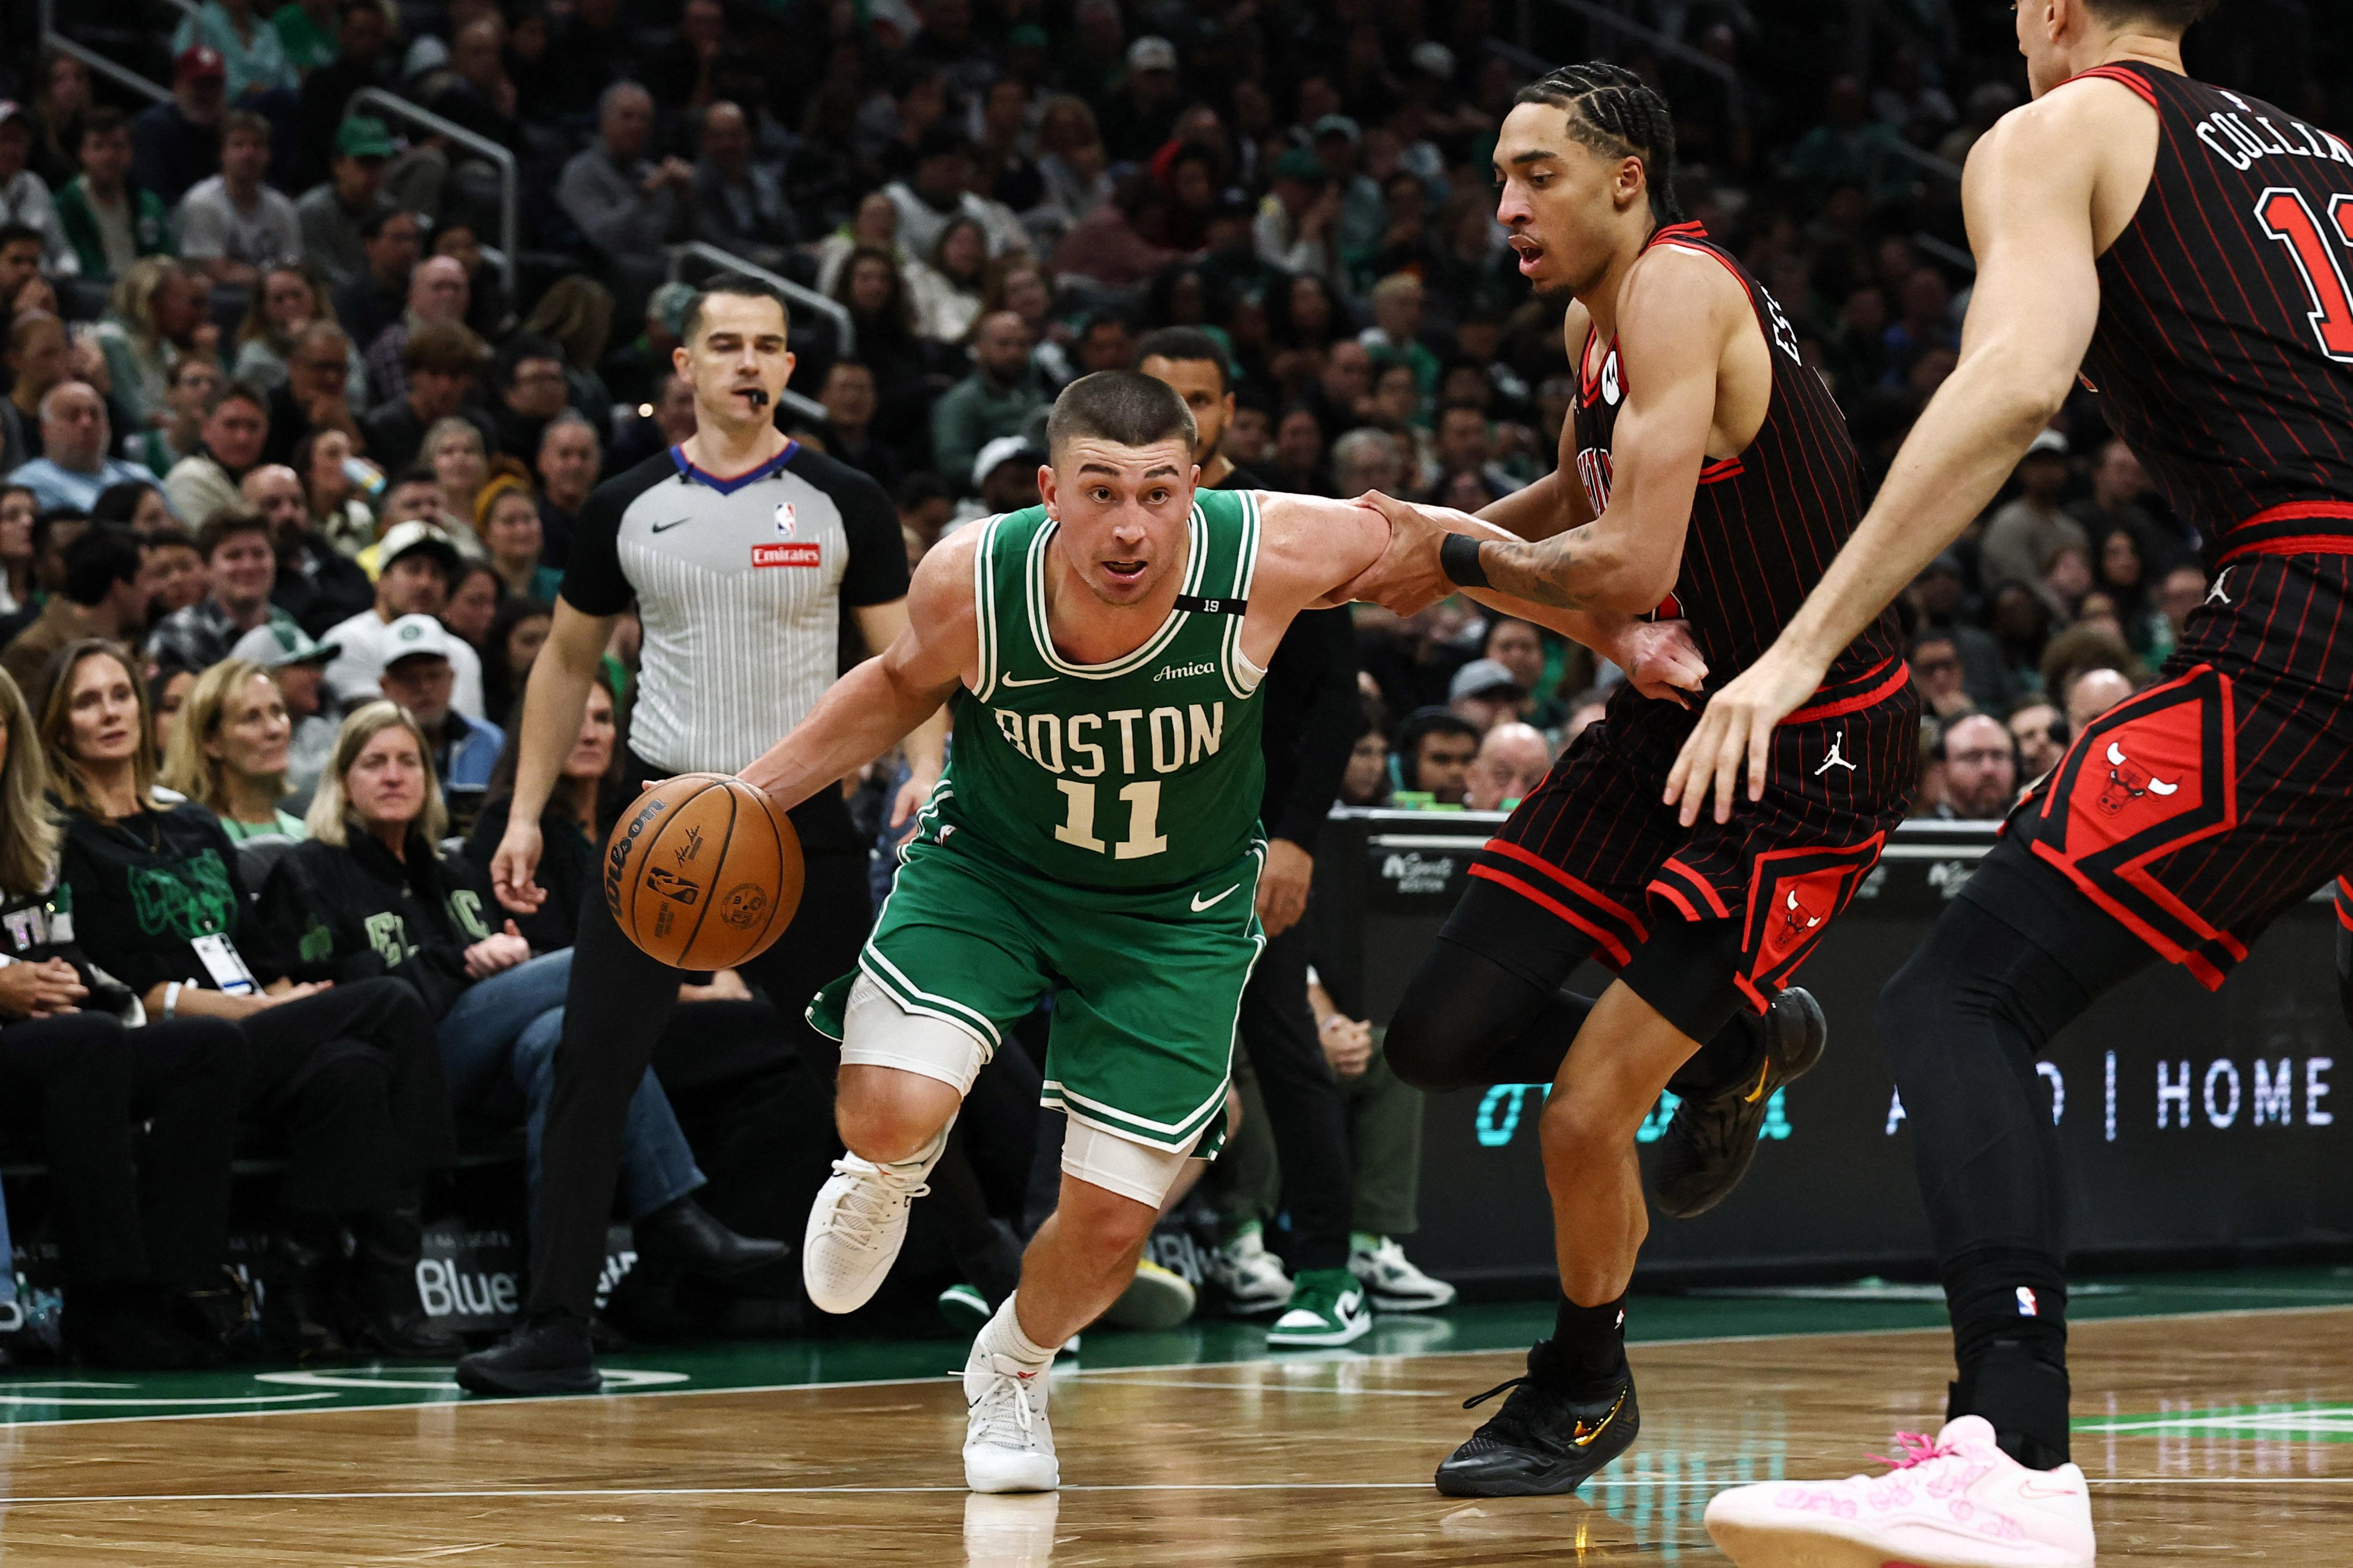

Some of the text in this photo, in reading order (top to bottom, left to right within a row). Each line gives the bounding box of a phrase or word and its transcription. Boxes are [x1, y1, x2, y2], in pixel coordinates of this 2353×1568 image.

[753, 546, 819, 563] Emirates
[1203, 599, 1220, 613] 19
[1153, 661, 1215, 682] Amica
[992, 701, 1224, 777] BOSTON
[1054, 778, 1168, 860] 11
[605, 798, 668, 920] Wilson
[2157, 1057, 2334, 1129] HOME
[415, 1258, 519, 1317] Blue
